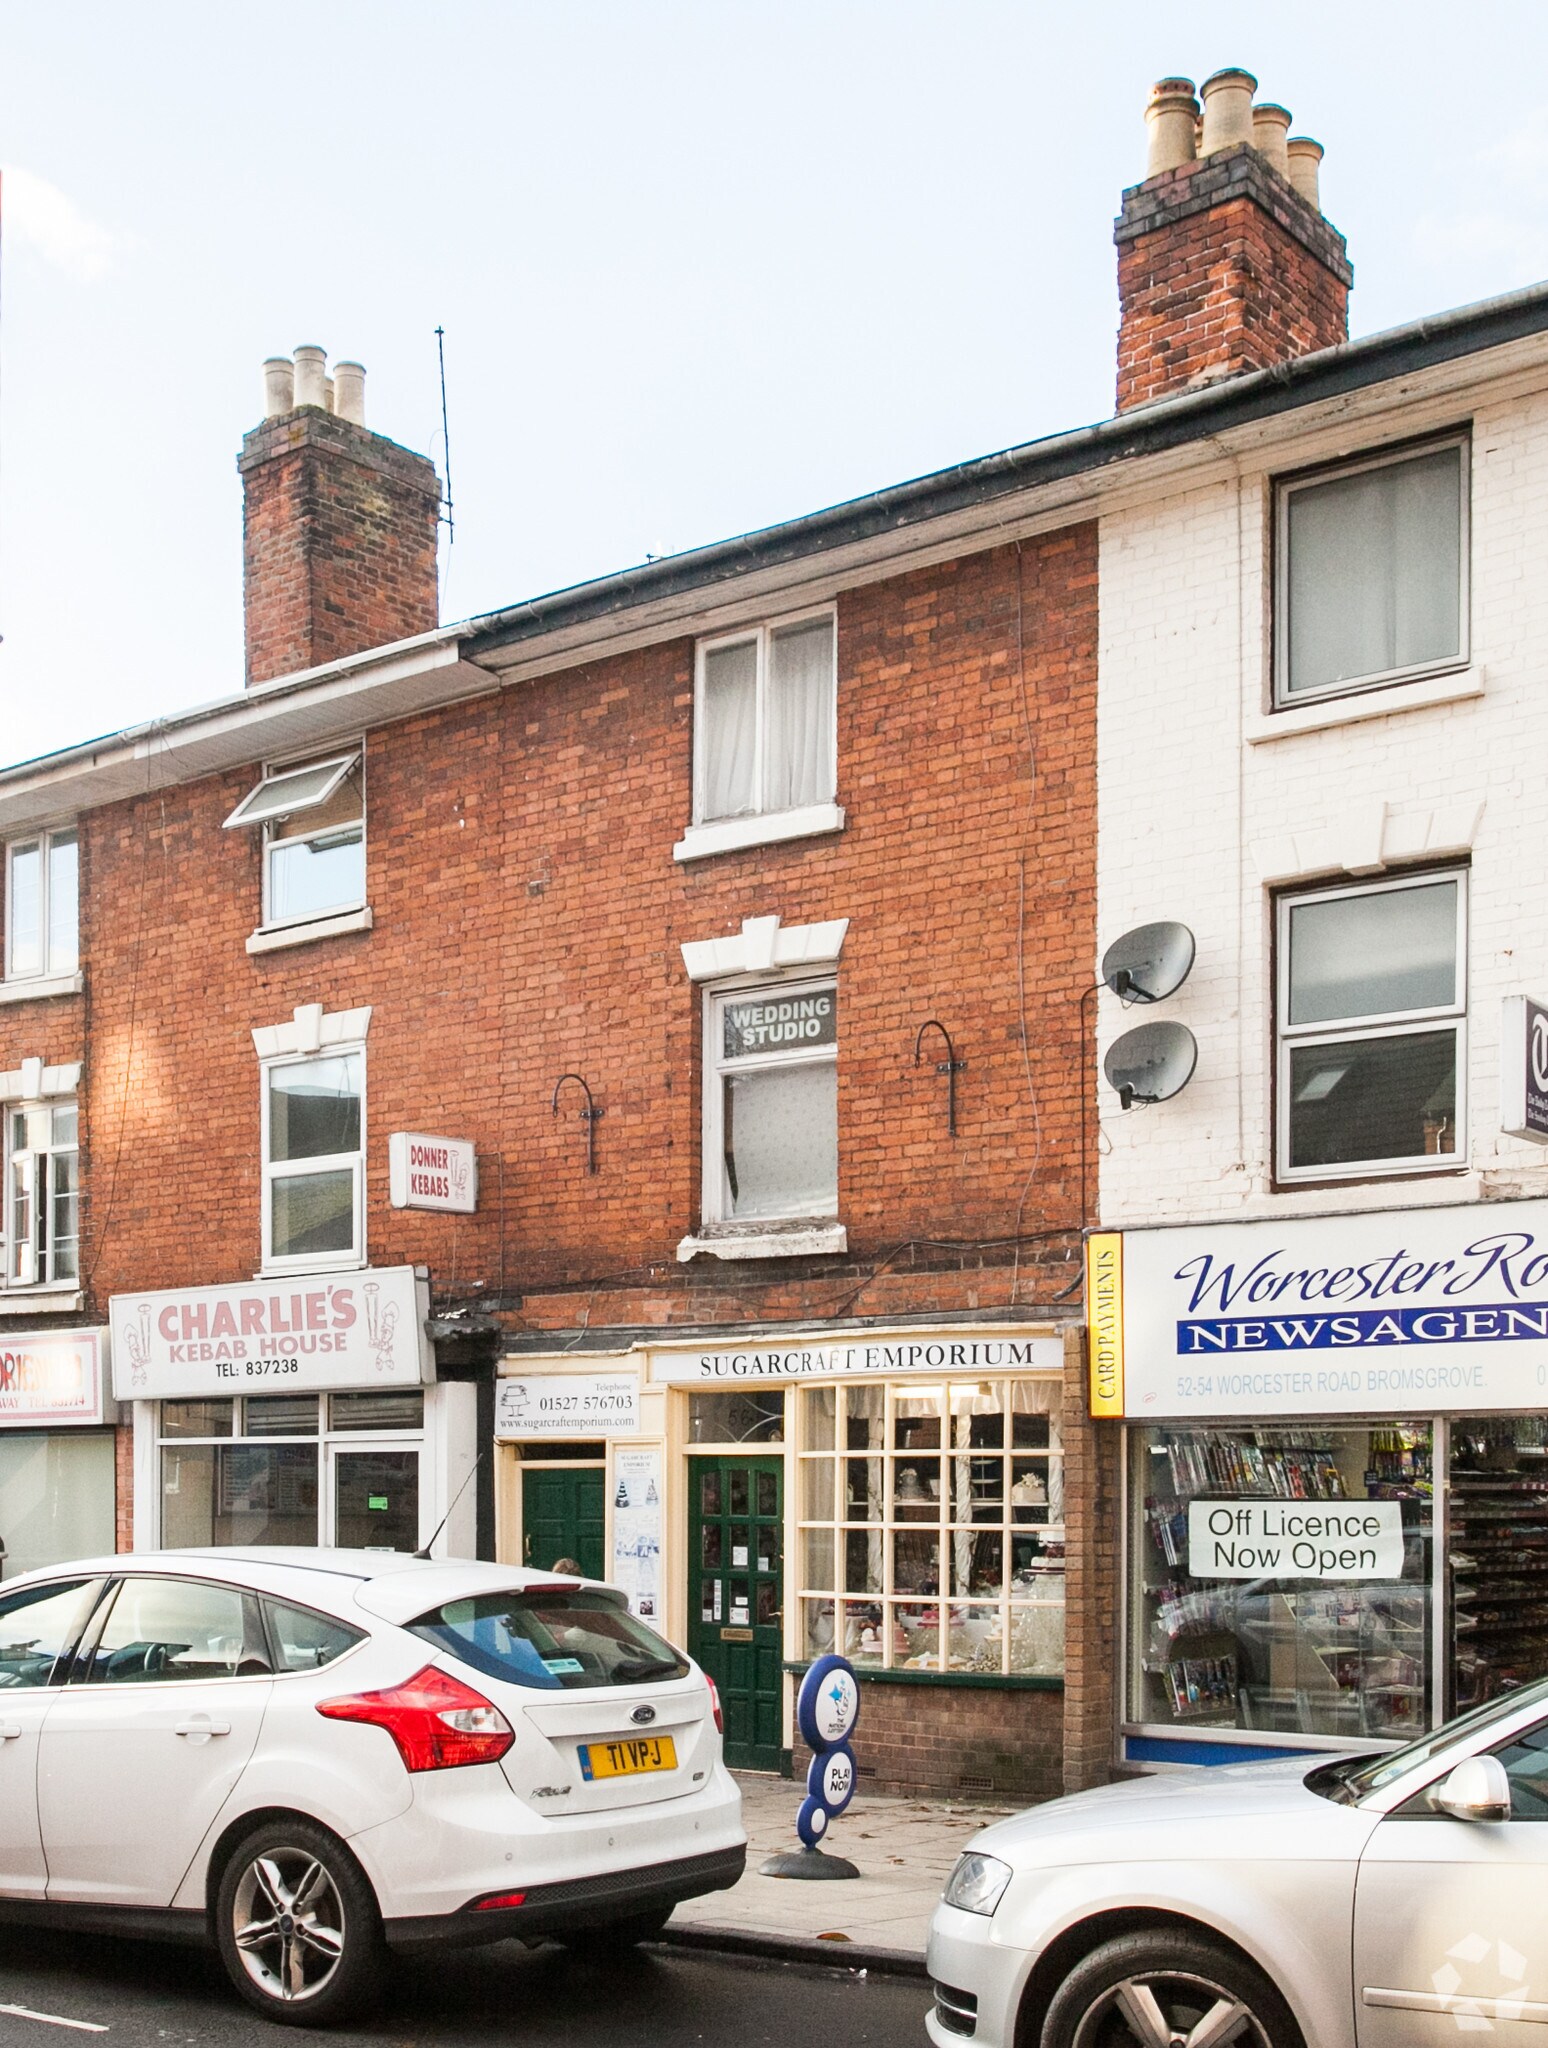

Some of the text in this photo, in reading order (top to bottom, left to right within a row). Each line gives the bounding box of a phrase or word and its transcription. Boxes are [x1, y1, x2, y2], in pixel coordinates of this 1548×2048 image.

[732, 997, 831, 1029] WEDDING
[742, 1018, 821, 1047] STUDIO
[411, 1145, 448, 1170] DONNER
[411, 1173, 449, 1198] KEBABS
[1174, 1249, 1456, 1313] Worcester
[158, 1285, 357, 1342] CHARLIE'S
[1096, 1250, 1116, 1399] CARD PAYMENTS
[169, 1332, 347, 1363] KEBAB HOUSE
[700, 1342, 1035, 1377] SUGARCRAFT EMPORIUM
[216, 1359, 298, 1377] TEL: 837238
[1177, 1376, 1213, 1396] 52-54
[1217, 1371, 1312, 1395] WORCESTER
[1317, 1369, 1361, 1392] ROAD
[595, 1383, 632, 1393] Telephone
[540, 1395, 633, 1411] 01527 576703
[500, 1416, 635, 1431] www.sugarcraftemporium.com
[1208, 1508, 1381, 1537] Off Licence
[1214, 1541, 1377, 1576] Now Open
